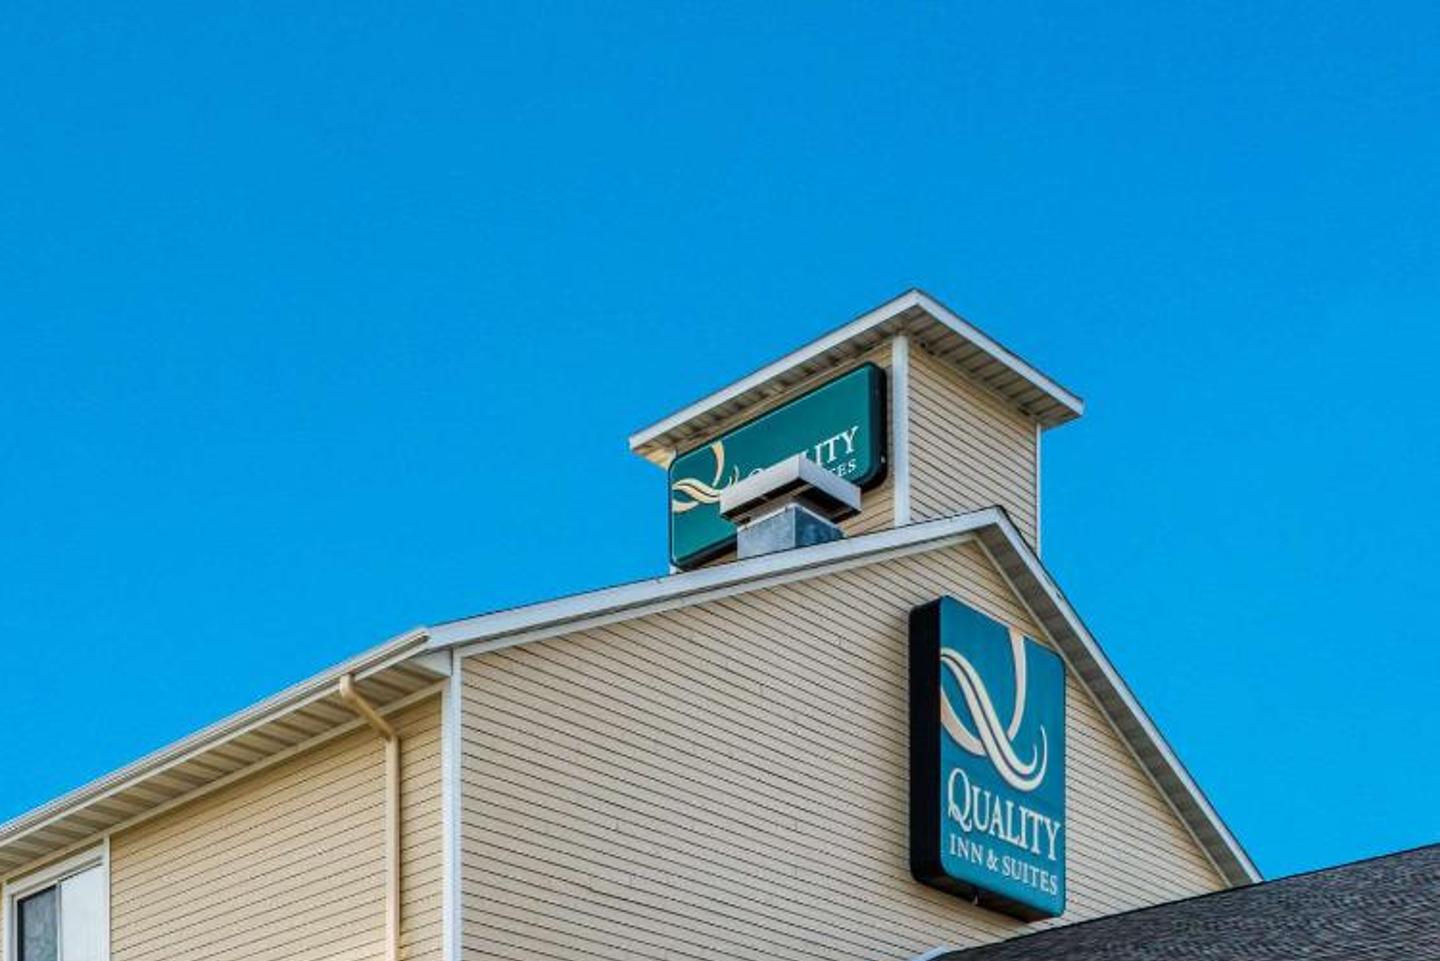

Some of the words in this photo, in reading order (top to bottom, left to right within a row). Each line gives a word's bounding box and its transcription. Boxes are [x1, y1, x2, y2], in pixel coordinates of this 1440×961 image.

[948, 767, 1060, 861] QUALITY
[949, 833, 983, 865] INN
[986, 849, 998, 872] &
[1002, 855, 1058, 895] SUITES
